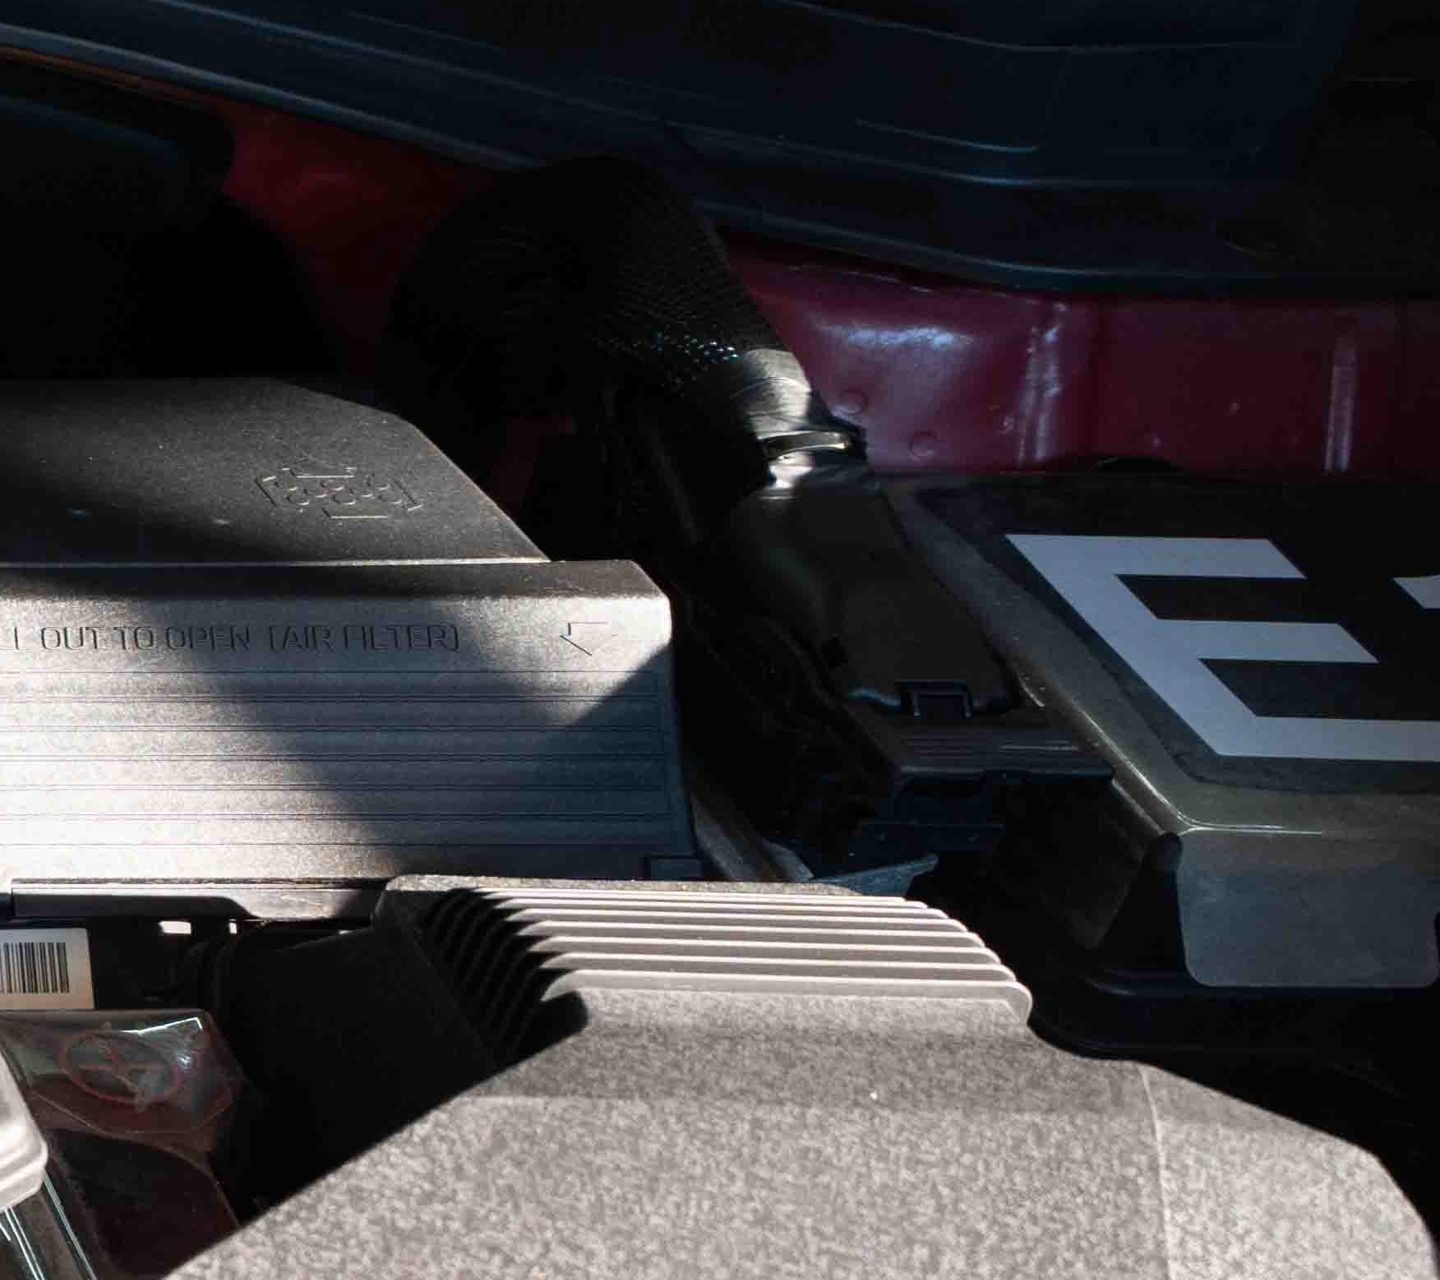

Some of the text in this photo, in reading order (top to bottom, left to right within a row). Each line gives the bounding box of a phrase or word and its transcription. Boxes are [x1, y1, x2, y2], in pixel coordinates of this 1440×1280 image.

[40, 625, 105, 652] OUT
[113, 625, 156, 651] TO
[165, 624, 251, 651] OPEN
